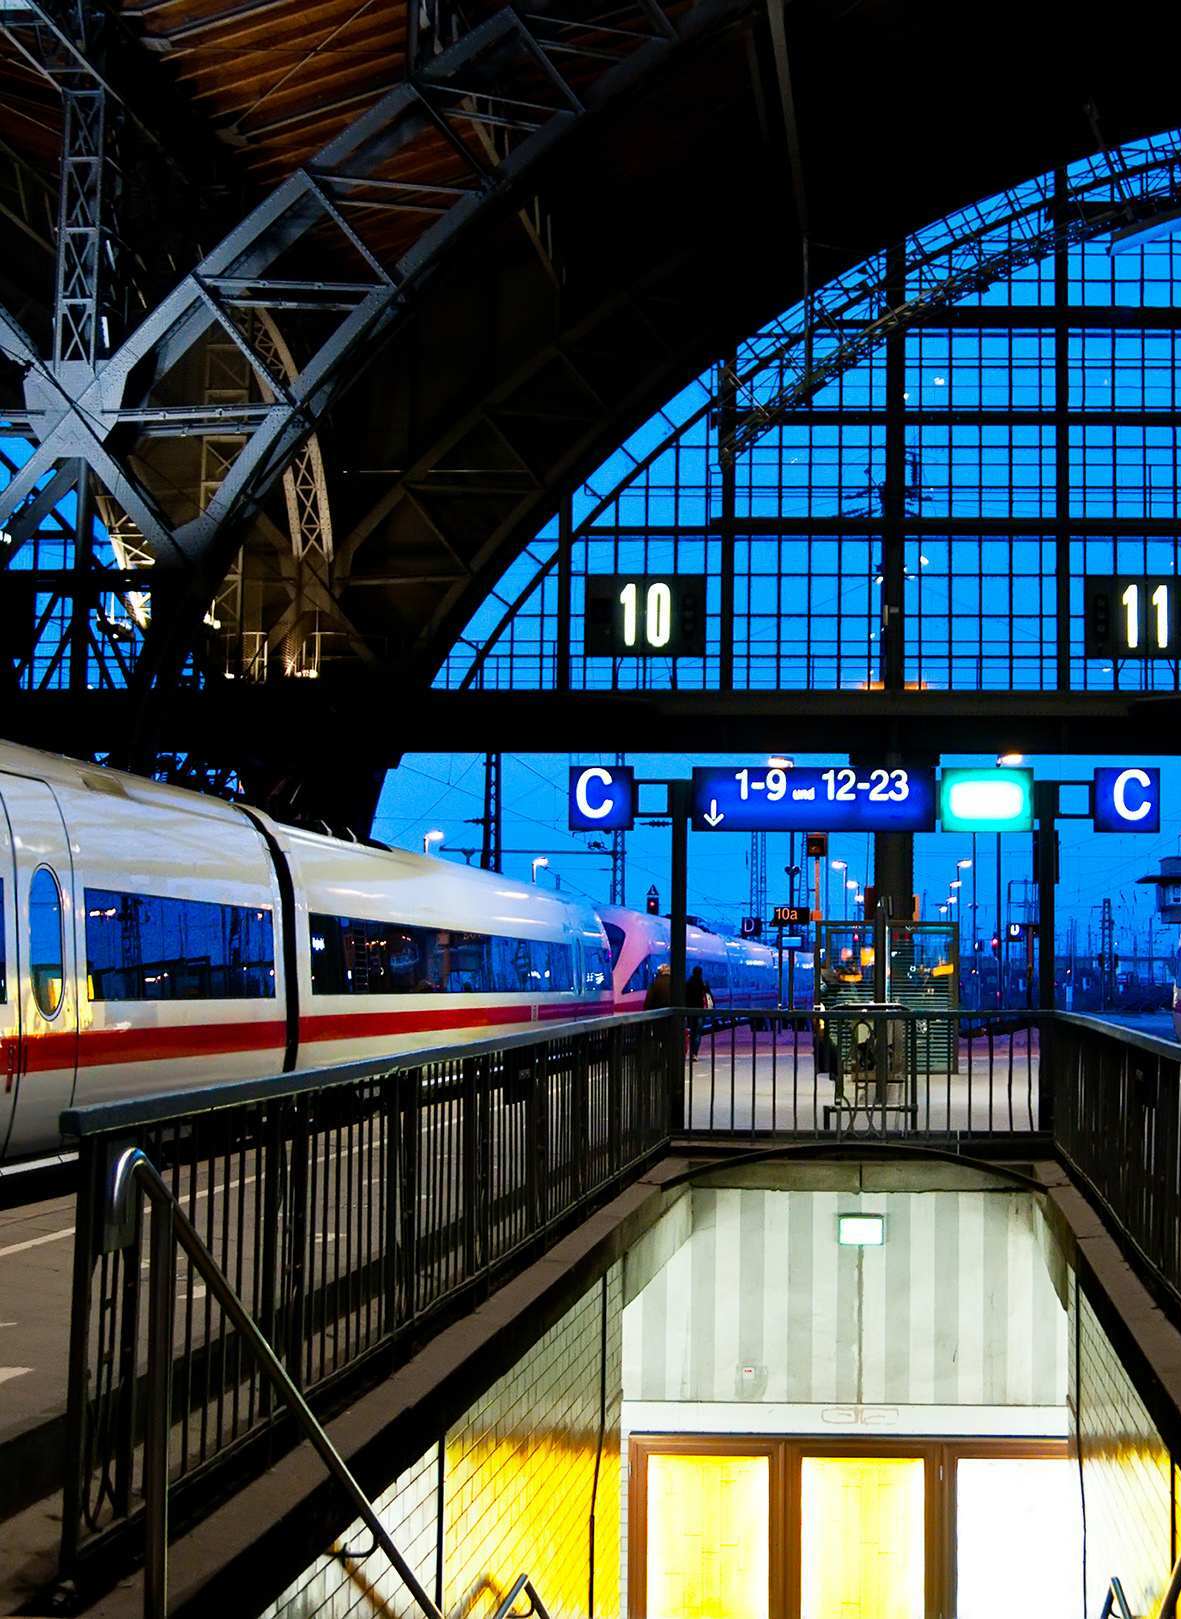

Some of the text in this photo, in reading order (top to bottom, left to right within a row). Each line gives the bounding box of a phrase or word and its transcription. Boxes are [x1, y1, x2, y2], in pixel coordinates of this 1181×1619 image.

[620, 582, 671, 648] 10
[1122, 584, 1168, 648] 11
[576, 767, 614, 819] C
[735, 768, 787, 801] 1-9
[821, 769, 910, 801] 12-23
[1113, 768, 1151, 821] C
[775, 907, 798, 920] 10a
